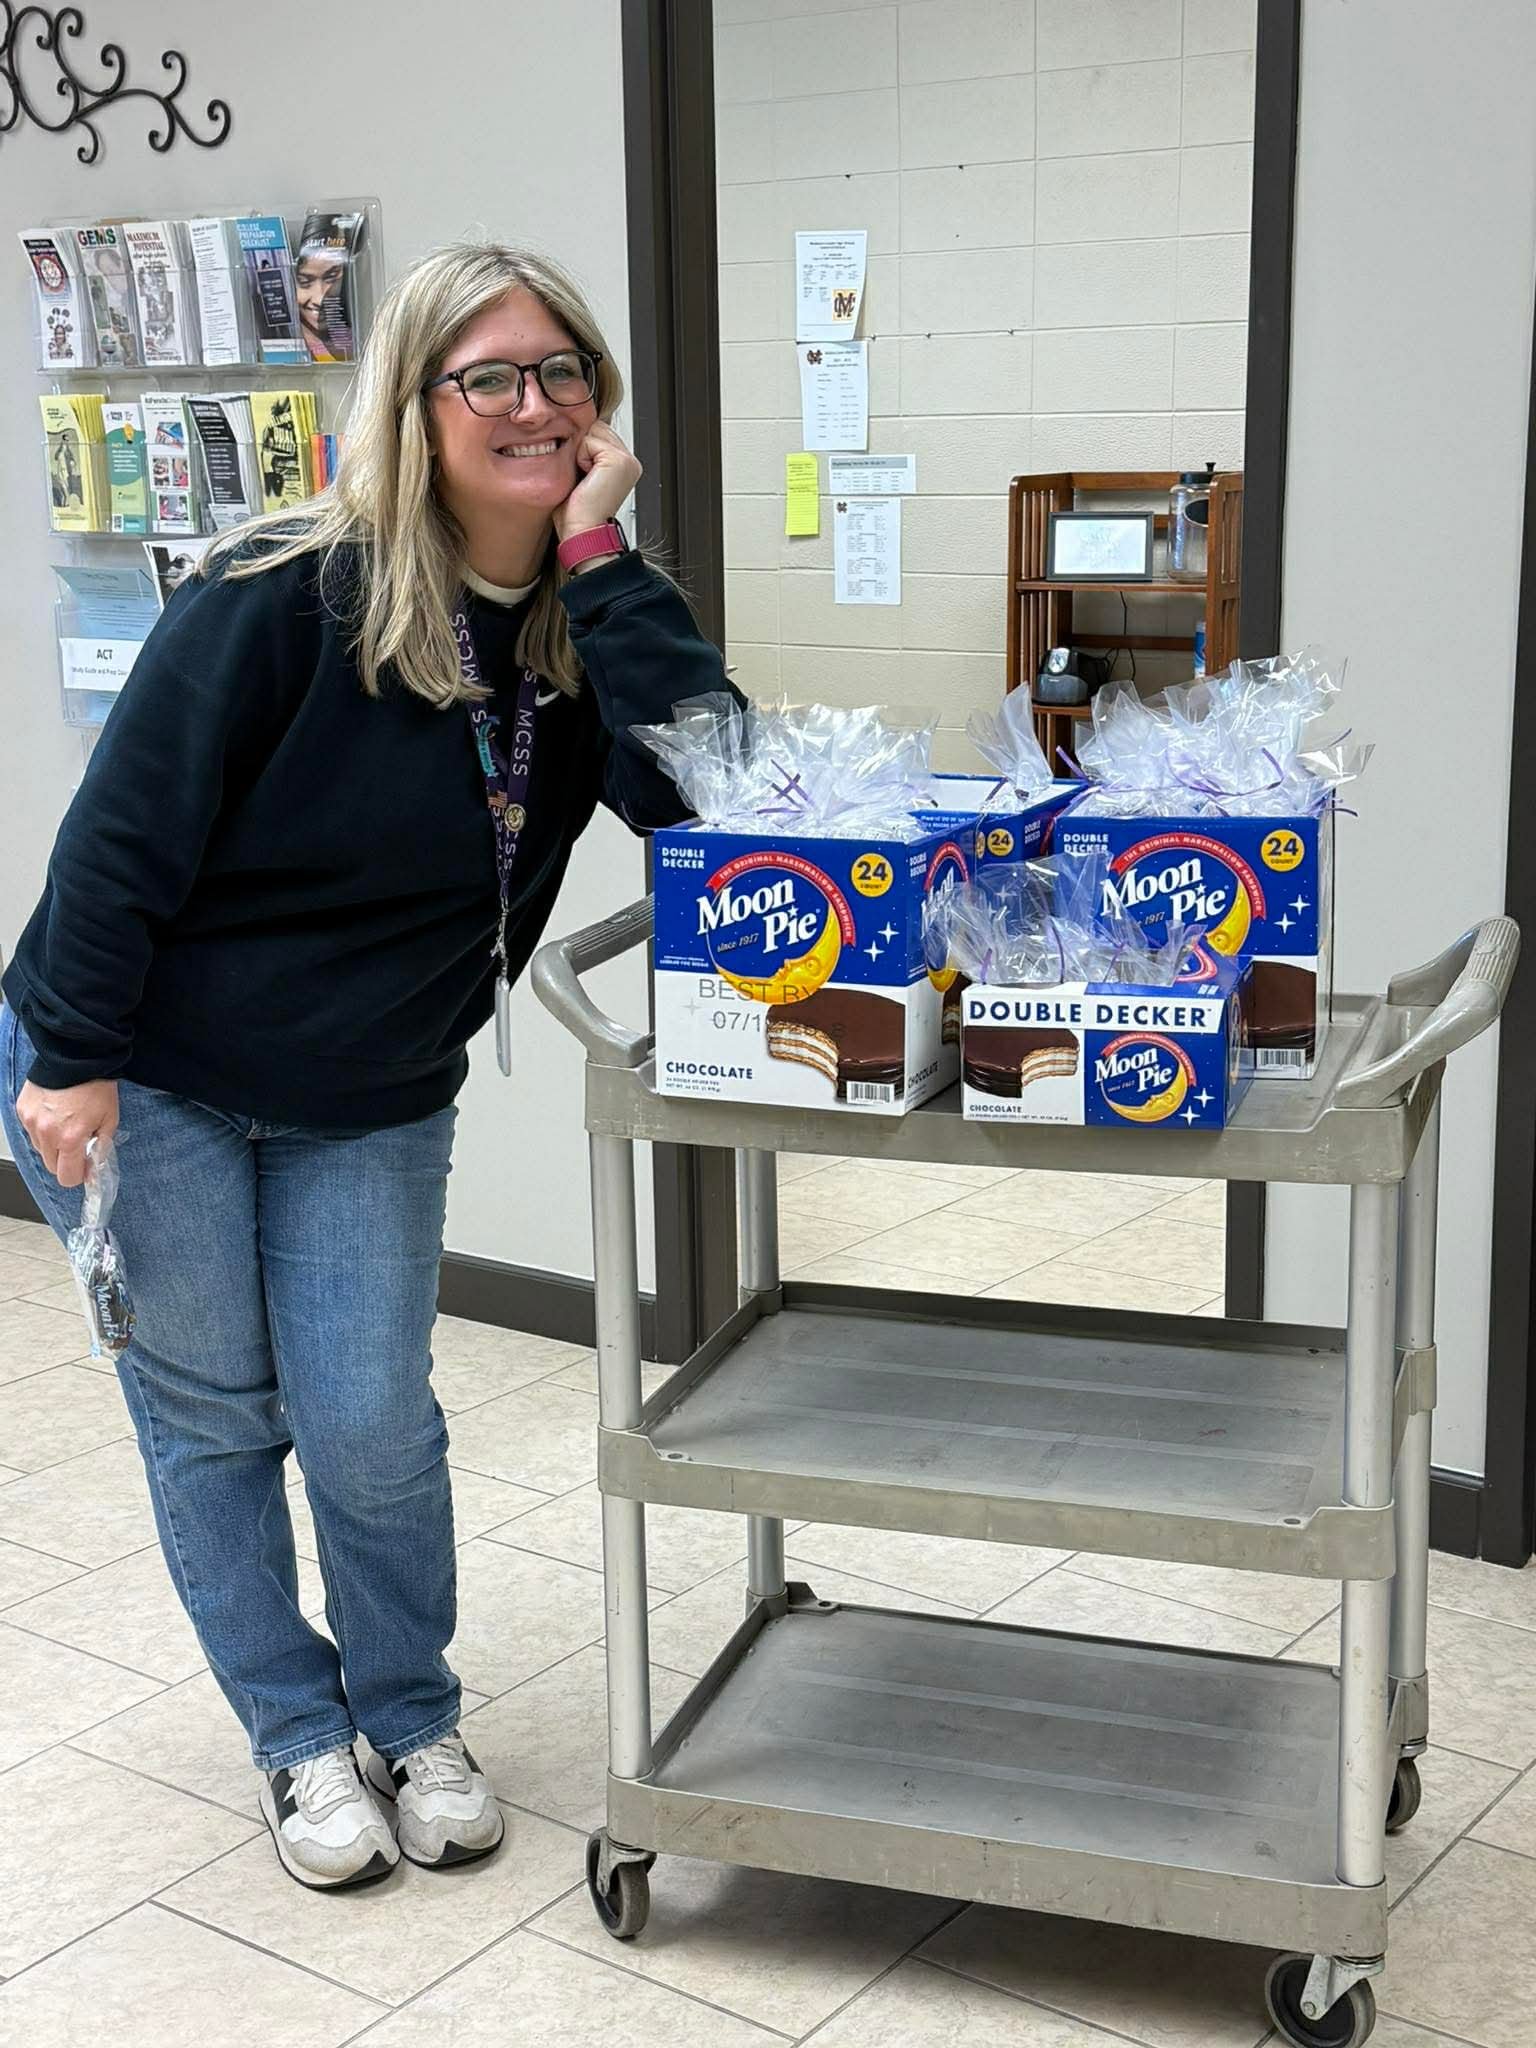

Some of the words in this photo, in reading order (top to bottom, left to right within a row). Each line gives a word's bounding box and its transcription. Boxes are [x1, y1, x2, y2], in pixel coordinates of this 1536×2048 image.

[77, 229, 117, 246] GEMS
[96, 649, 113, 660] ACT
[512, 708, 534, 776] MCSS
[991, 833, 1011, 846] 24
[1063, 833, 1109, 843] DOUBLE
[1139, 836, 1180, 852] ORIGINAL
[1267, 837, 1299, 857] 24
[661, 847, 705, 859] DOUBLE
[1063, 844, 1109, 854] DECKER
[662, 857, 705, 869] DECKER
[857, 860, 888, 881] 24
[1100, 857, 1203, 920] Moon
[696, 879, 796, 935] Moon
[1169, 883, 1227, 927] Pie
[762, 905, 818, 954] Pie
[738, 932, 759, 947] 1917
[699, 978, 773, 1004] BEST
[969, 1000, 1082, 1022] DOUBLE
[1096, 1004, 1206, 1027] DECKER
[666, 1061, 753, 1080] CHOCOLATE
[1095, 1048, 1158, 1083] Moon
[1137, 1064, 1173, 1092] Pie
[969, 1104, 1023, 1113] CHOCOLATE
